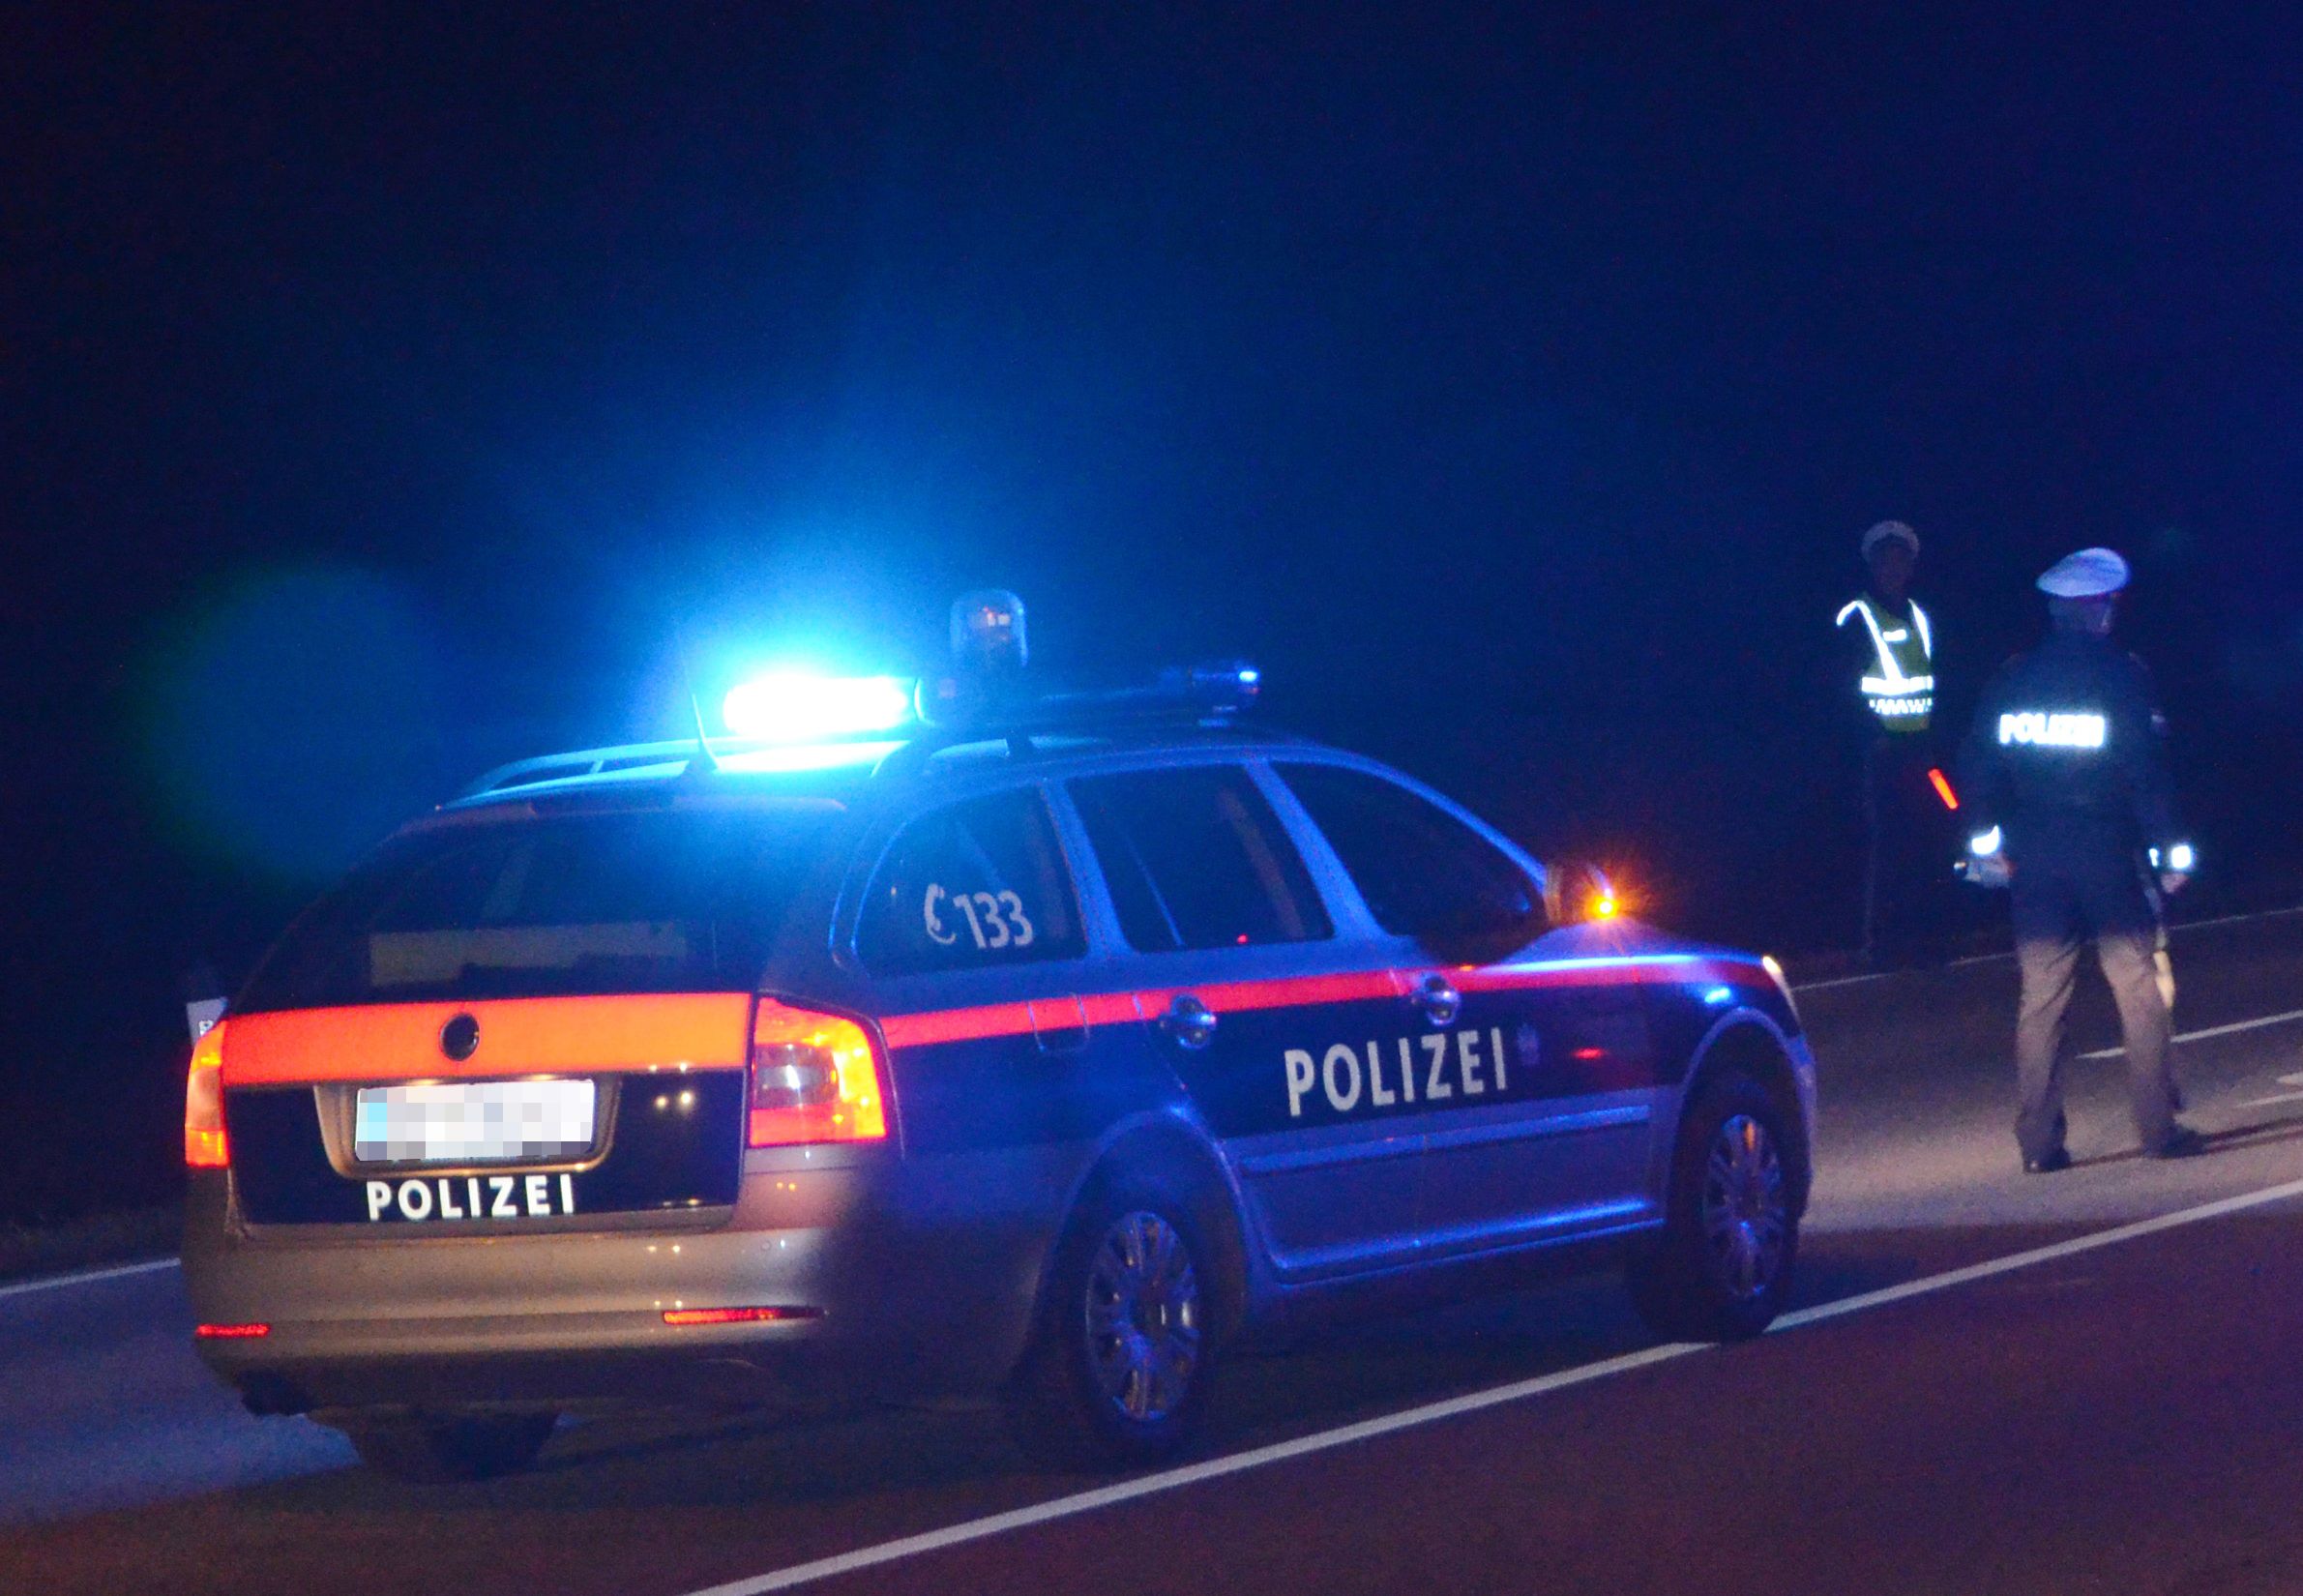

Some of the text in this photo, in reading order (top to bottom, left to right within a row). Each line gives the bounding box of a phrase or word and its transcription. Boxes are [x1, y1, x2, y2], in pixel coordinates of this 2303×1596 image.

[953, 889, 1034, 949] 133
[1284, 1026, 1507, 1117] POLIZEI
[366, 1173, 575, 1222] POLIZEI
